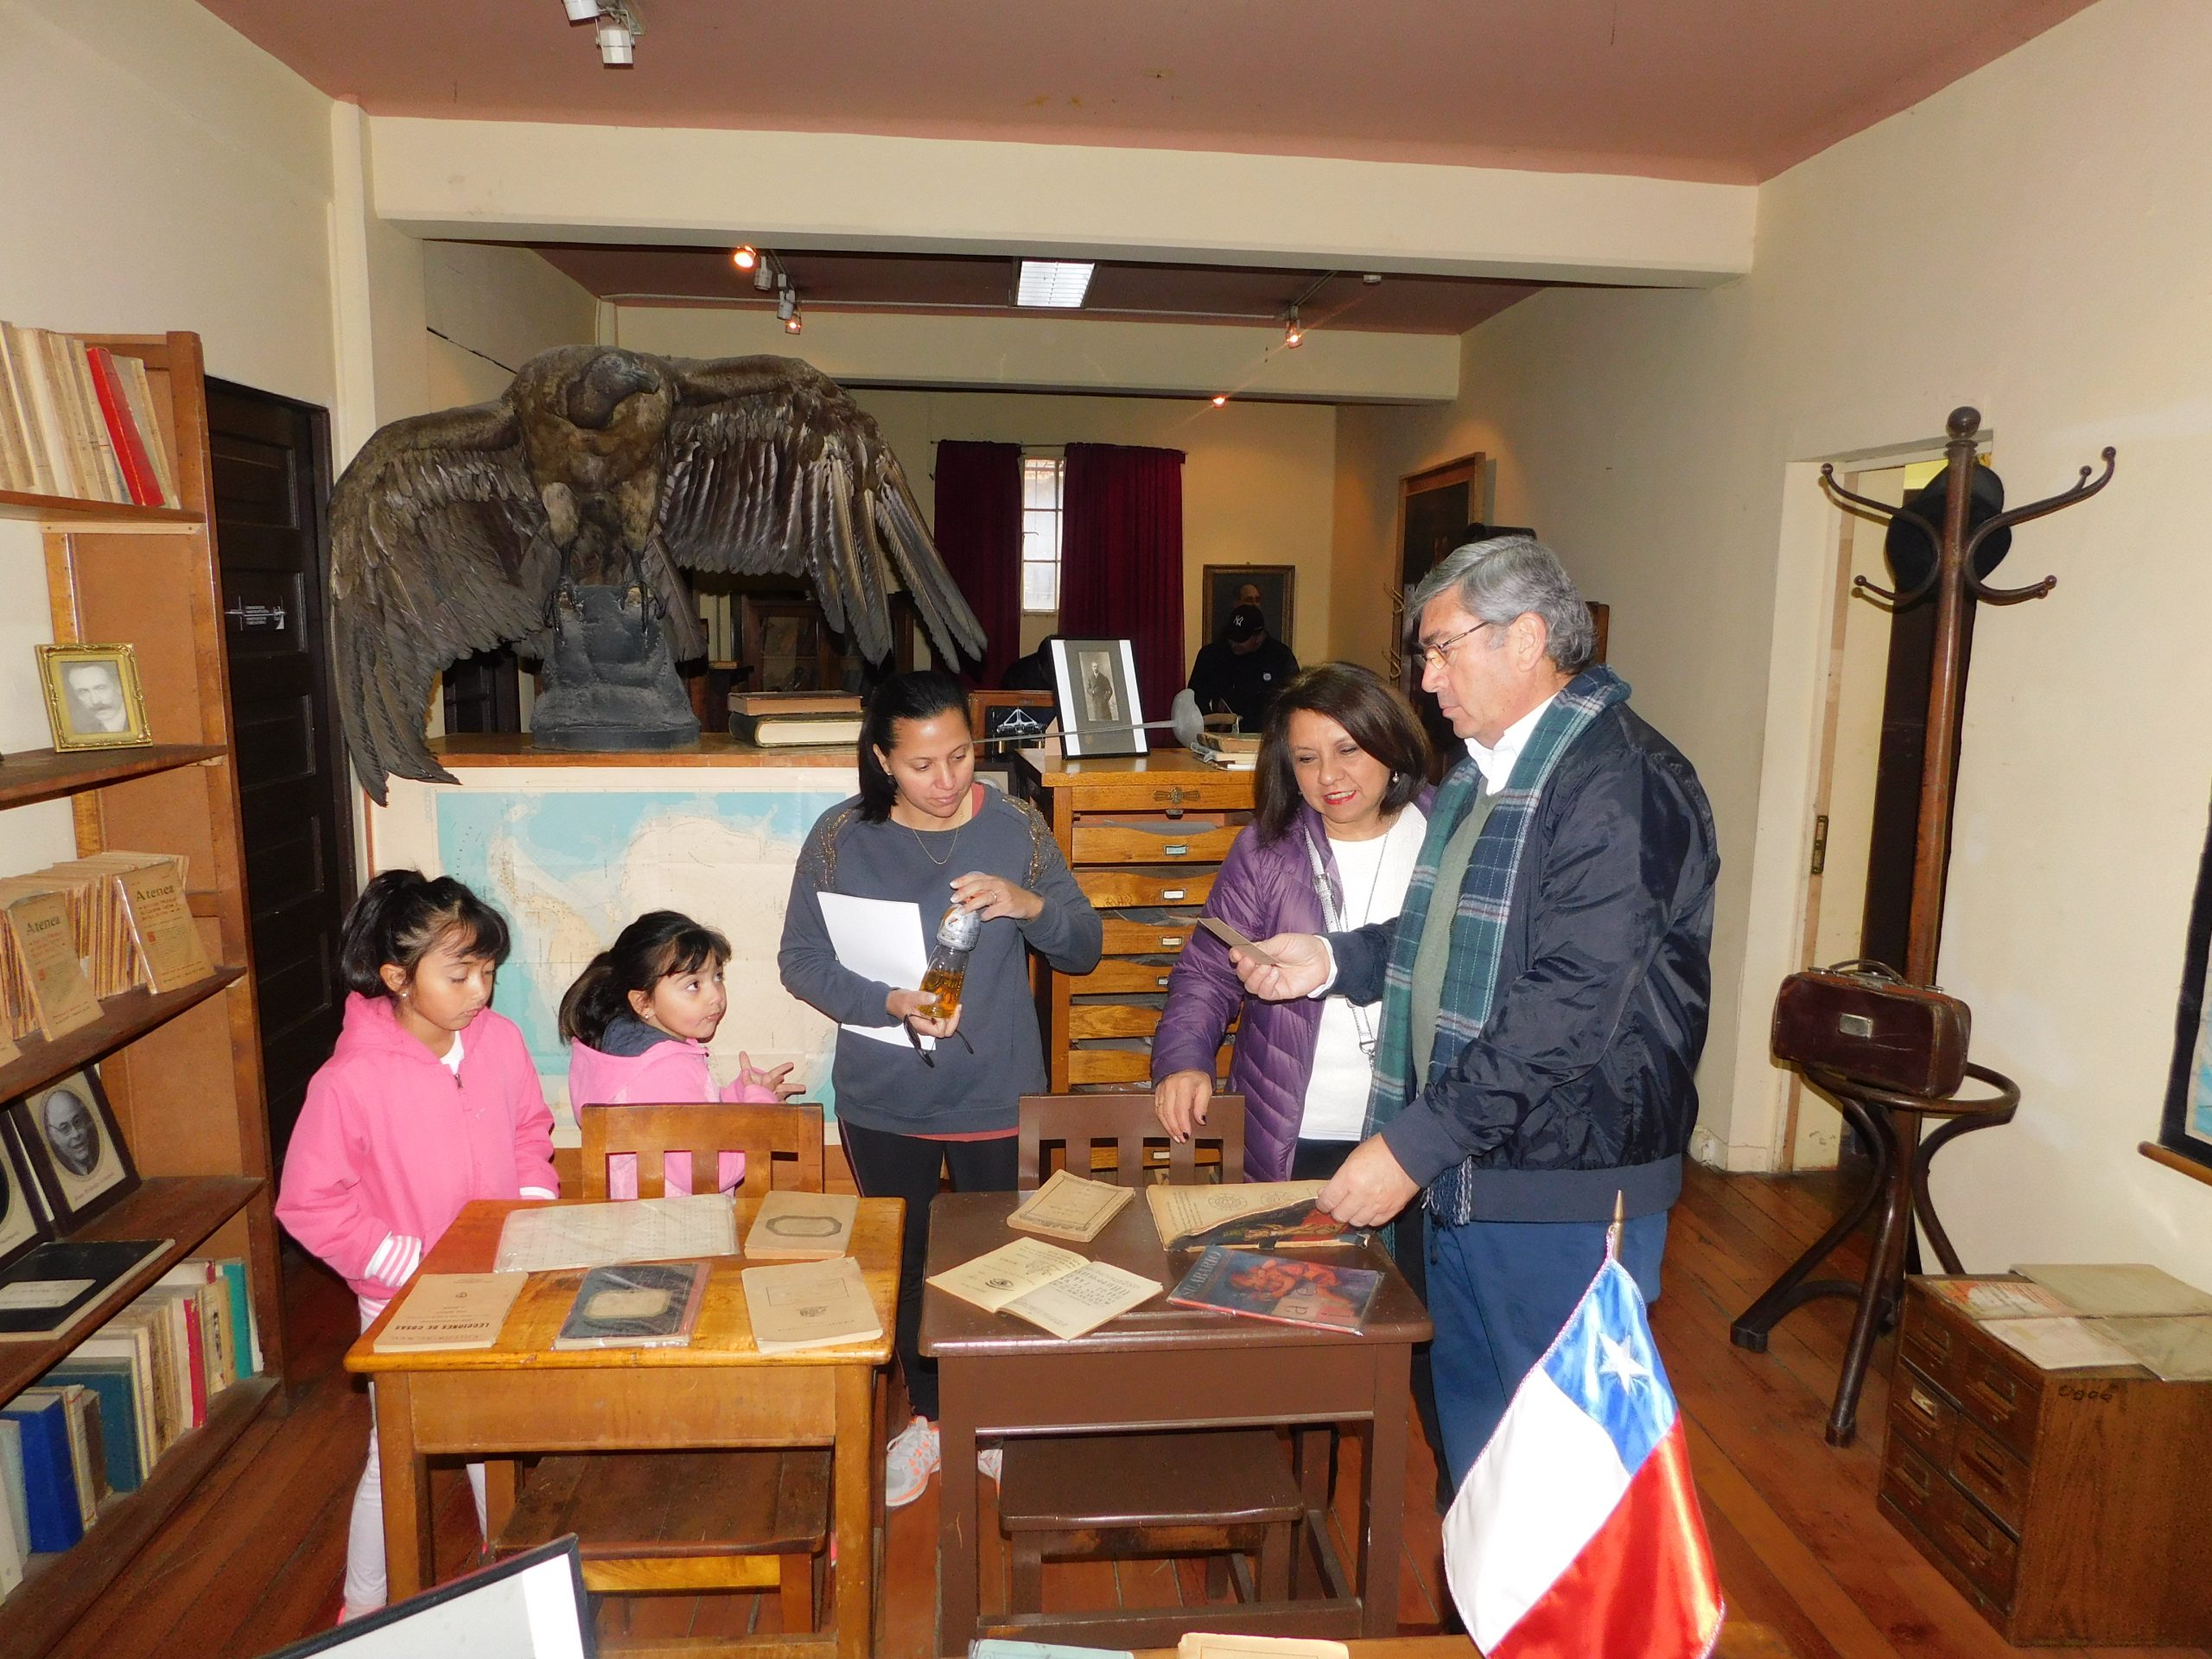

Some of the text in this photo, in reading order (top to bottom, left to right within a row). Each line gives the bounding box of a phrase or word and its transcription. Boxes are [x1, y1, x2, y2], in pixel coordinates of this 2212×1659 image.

[137, 885, 175, 902] Atenea
[26, 916, 61, 935] Atenea
[1182, 1250, 1222, 1298] SILABARIO
[442, 1322, 491, 1332] LECCIONES
